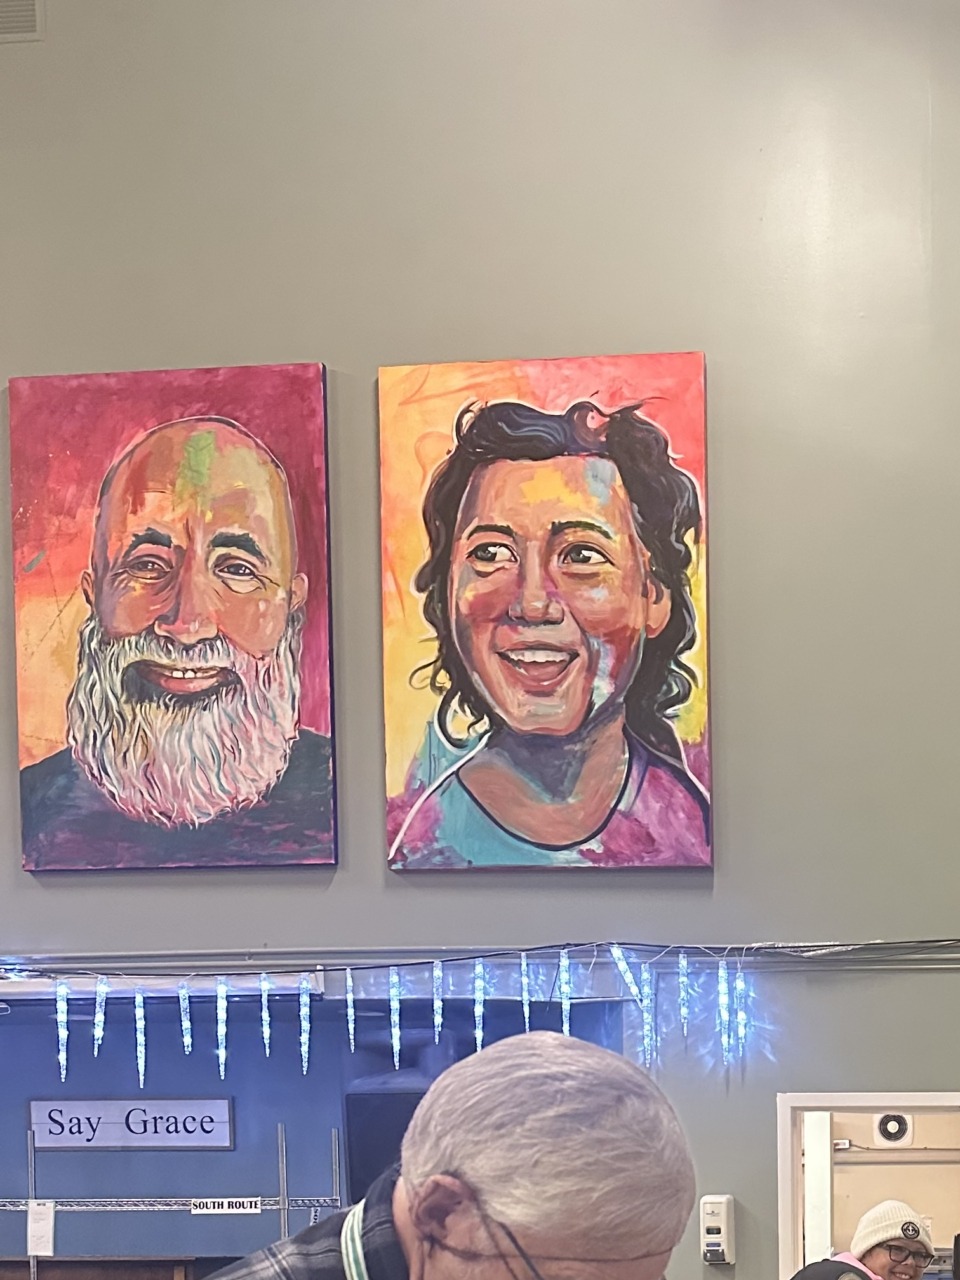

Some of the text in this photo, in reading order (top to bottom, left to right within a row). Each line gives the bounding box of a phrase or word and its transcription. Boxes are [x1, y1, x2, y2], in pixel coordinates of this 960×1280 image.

[48, 1107, 215, 1142] Say Grace
[192, 1200, 260, 1210] SOUTH ROUTE
